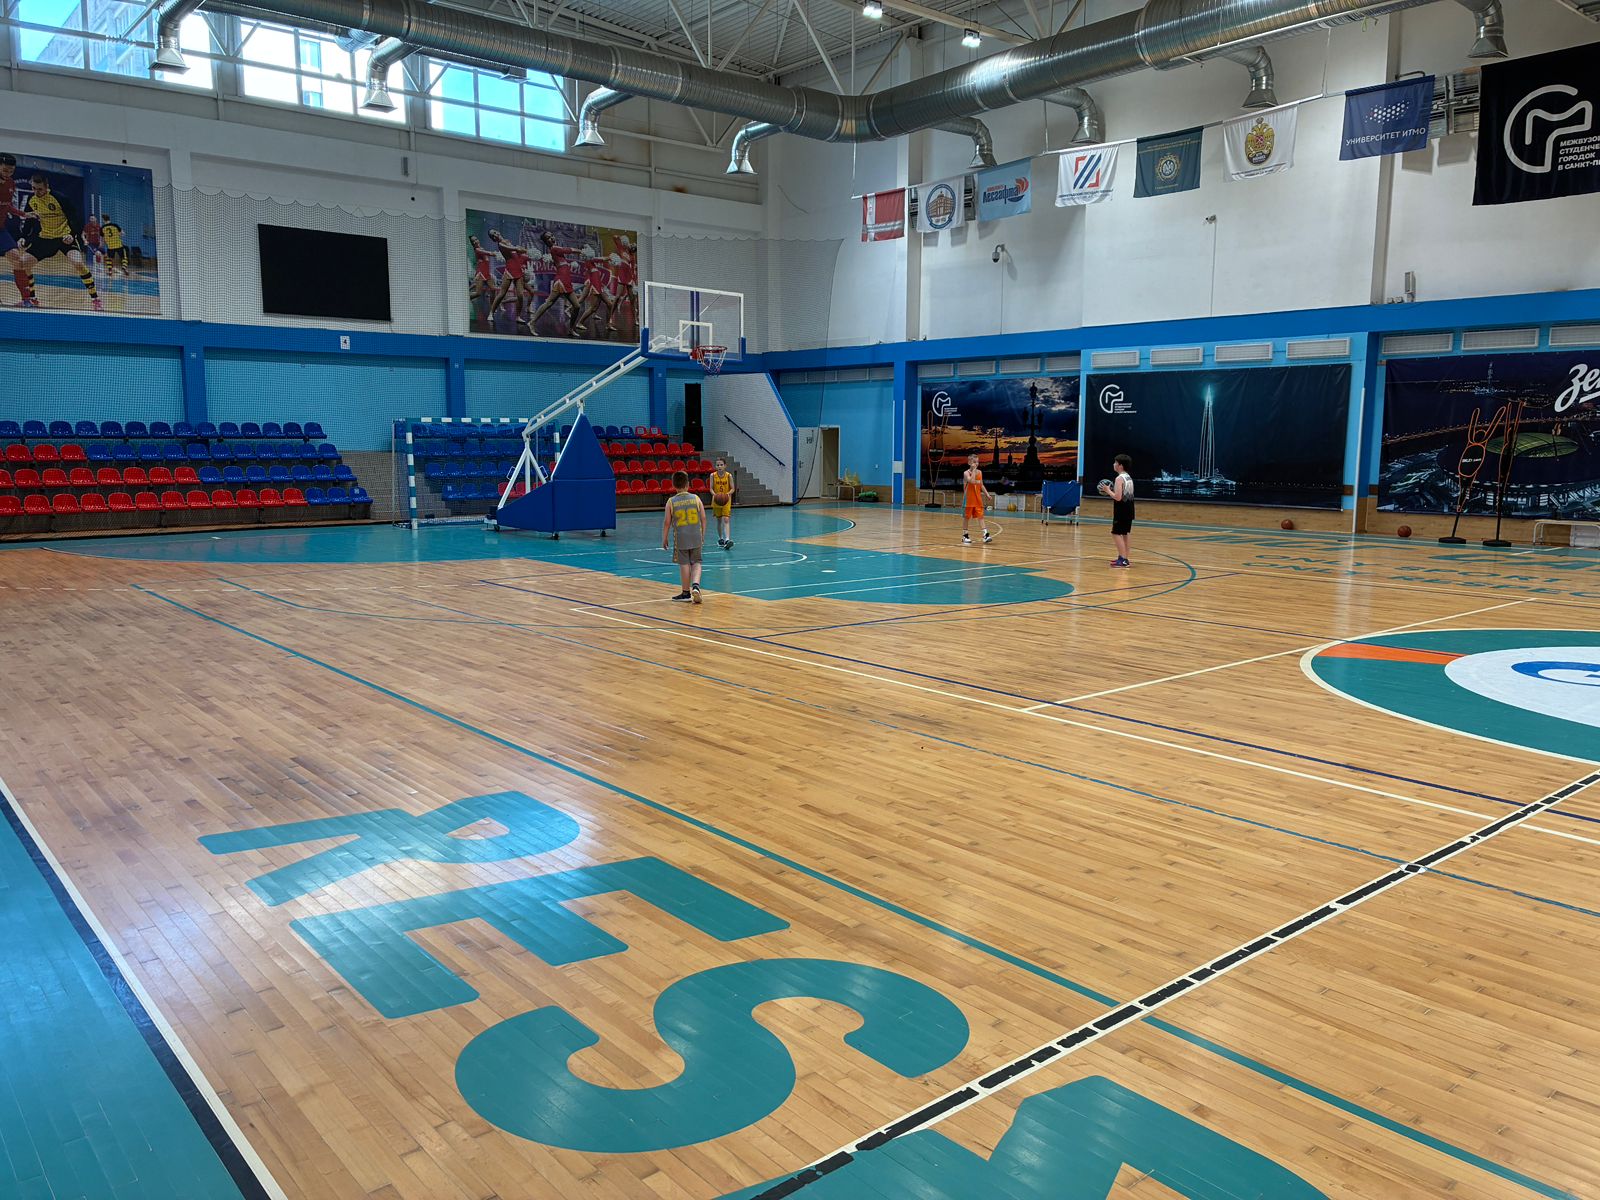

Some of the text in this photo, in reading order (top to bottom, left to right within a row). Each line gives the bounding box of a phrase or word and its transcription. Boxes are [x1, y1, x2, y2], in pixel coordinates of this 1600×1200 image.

[1346, 127, 1426, 146] УНИВЕРСИТЕТ ИТМО
[1558, 151, 1596, 163] ГОРОДОК
[676, 508, 699, 527] 26
[1241, 562, 1376, 576] ONLY
[1255, 554, 1571, 583] ONLY SPORT
